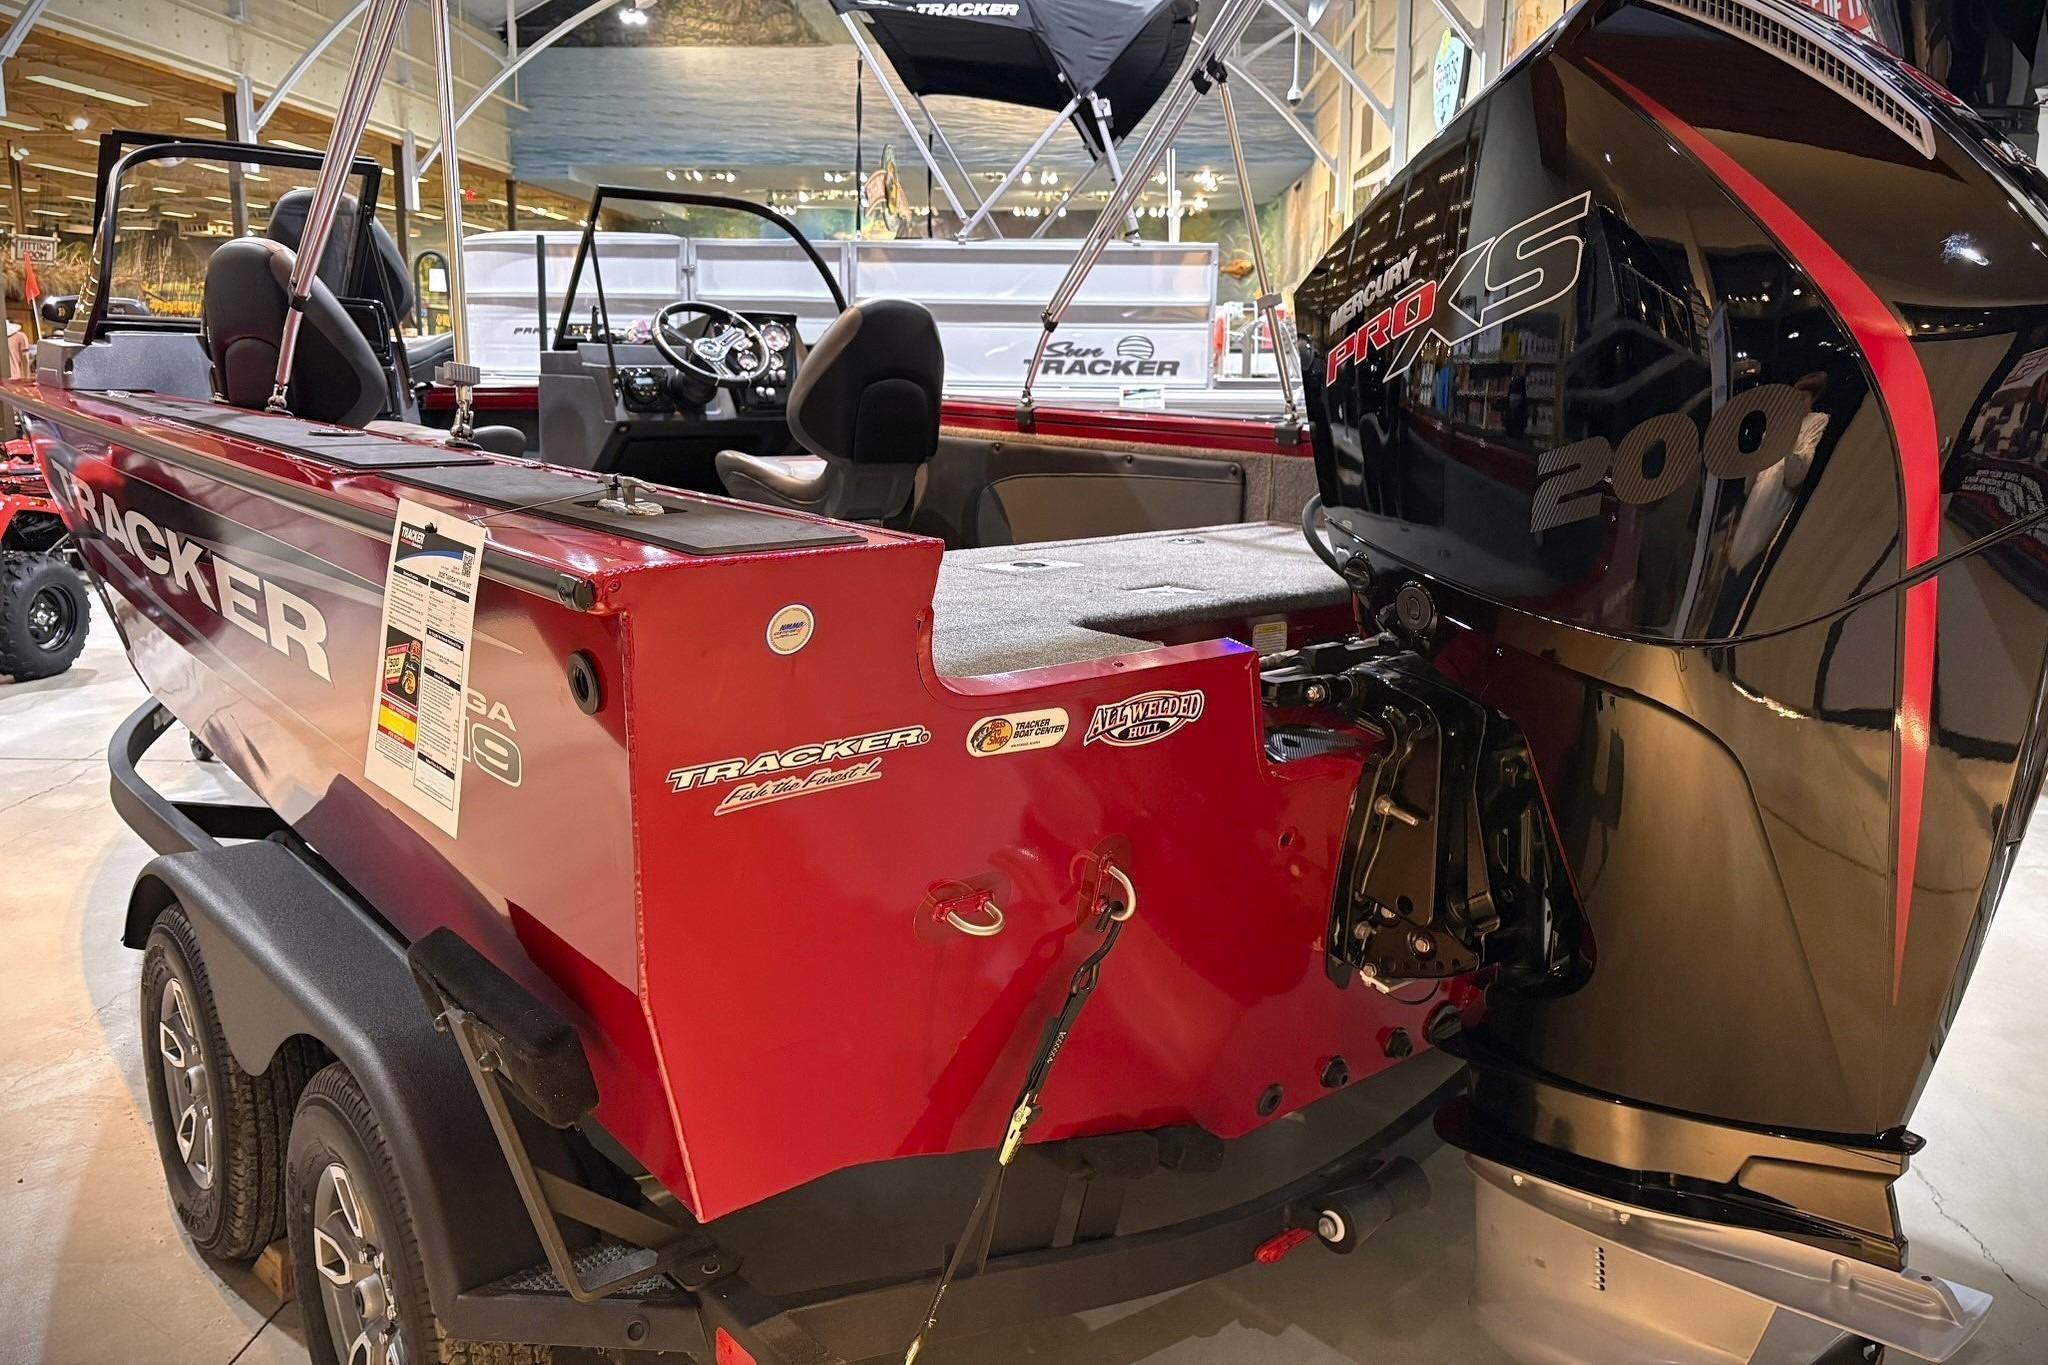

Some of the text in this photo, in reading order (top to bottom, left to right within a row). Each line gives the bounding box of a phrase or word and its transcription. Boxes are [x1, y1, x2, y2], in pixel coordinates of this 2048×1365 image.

[914, 3, 1020, 17] TRACKER
[1329, 248, 1418, 336] MERCURY
[1326, 279, 1437, 388] PRO
[1043, 341, 1104, 358] Sun
[1024, 359, 1181, 377] TRACKER
[1529, 383, 1802, 533] 200
[401, 526, 426, 545] TRACKER
[51, 460, 332, 685] TRACKER
[1015, 718, 1051, 731] TRACKER
[1087, 693, 1201, 740] ALL WELDED
[1013, 724, 1065, 739] BOAT CENTER
[1127, 722, 1161, 739] HULL
[987, 735, 1009, 746] Shops
[724, 783, 768, 804] Fish
[772, 779, 800, 795] the
